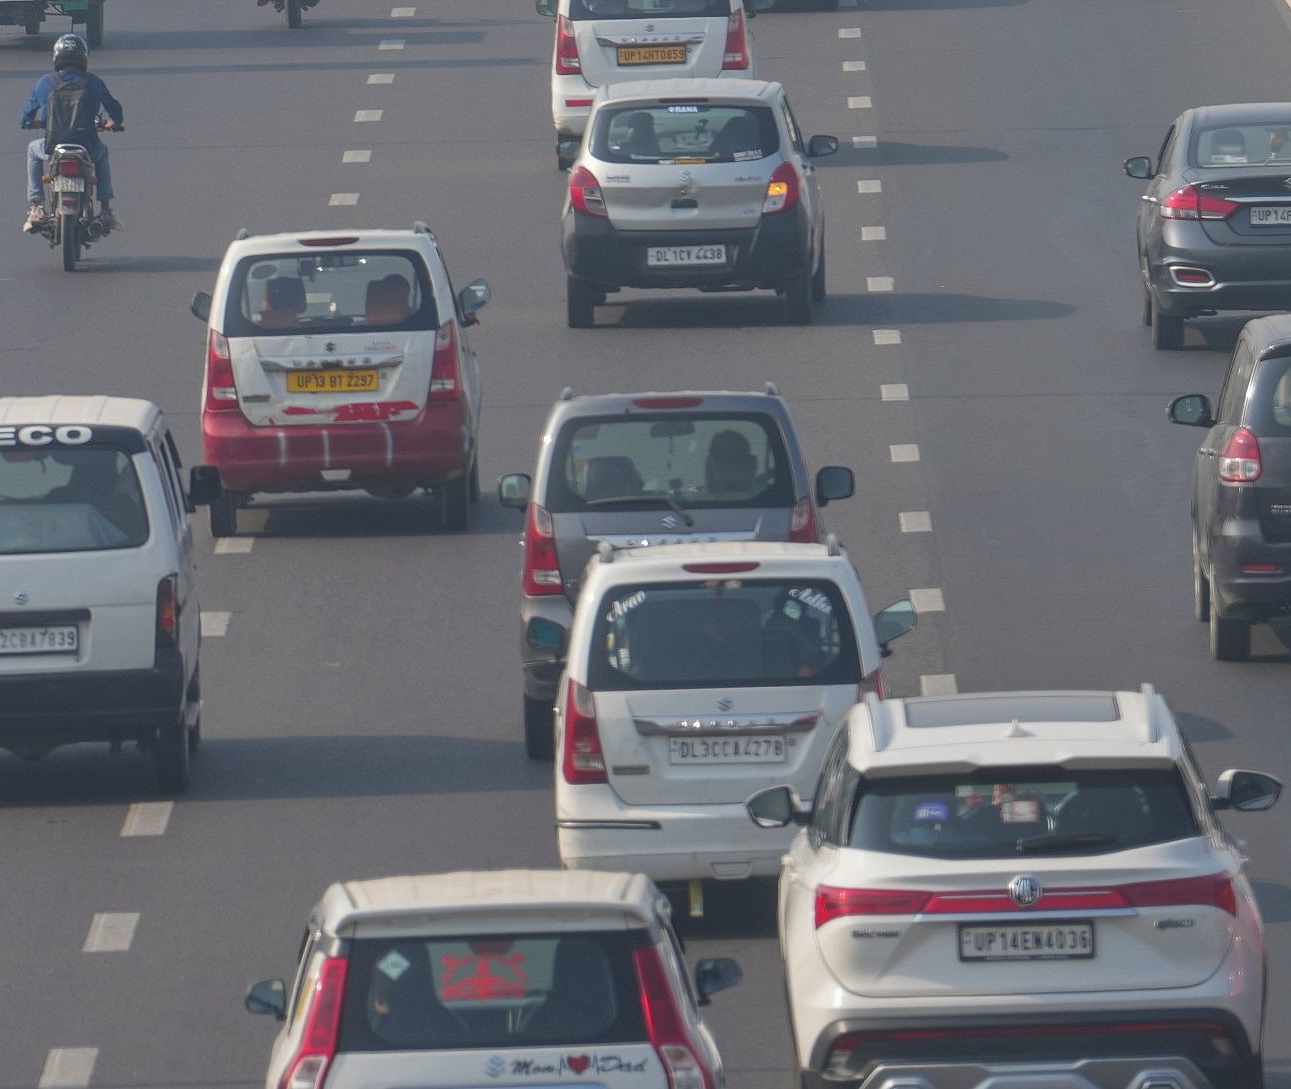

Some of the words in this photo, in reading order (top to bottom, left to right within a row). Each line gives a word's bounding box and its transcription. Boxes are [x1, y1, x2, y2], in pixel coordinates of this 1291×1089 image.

[656, 250, 668, 262] DL
[297, 375, 310, 388] UP
[329, 375, 344, 387] BT
[347, 374, 375, 387] 2297
[511, 1058, 556, 1076] Mom
[599, 1056, 648, 1073] Dad
